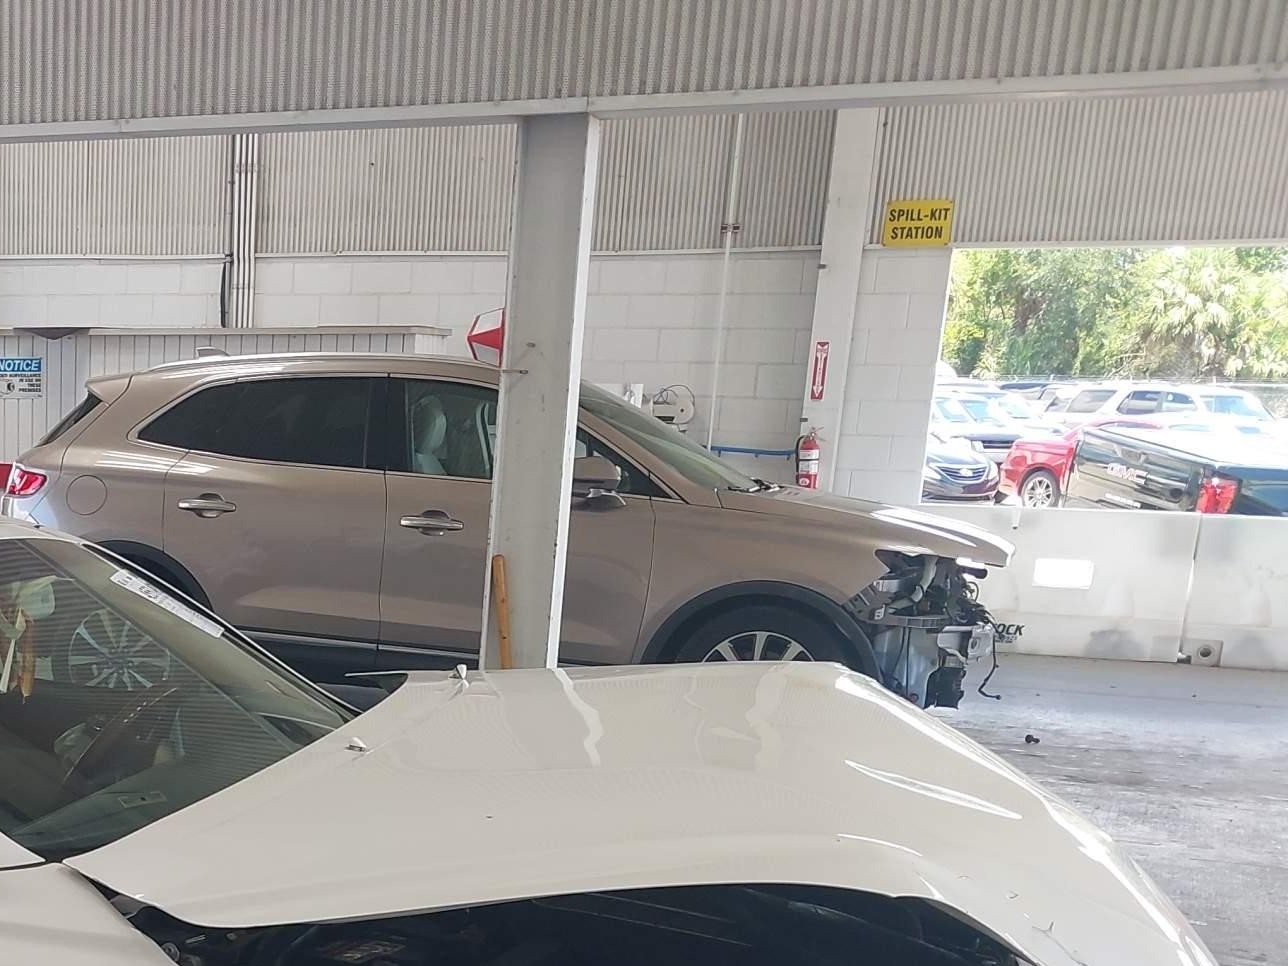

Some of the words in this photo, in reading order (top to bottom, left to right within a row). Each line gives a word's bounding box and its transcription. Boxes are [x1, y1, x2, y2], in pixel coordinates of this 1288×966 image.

[888, 208, 951, 222] SPILL-KIT
[890, 226, 944, 240] STATION
[1106, 463, 1149, 485] GMC
[994, 623, 1025, 636] OCK
